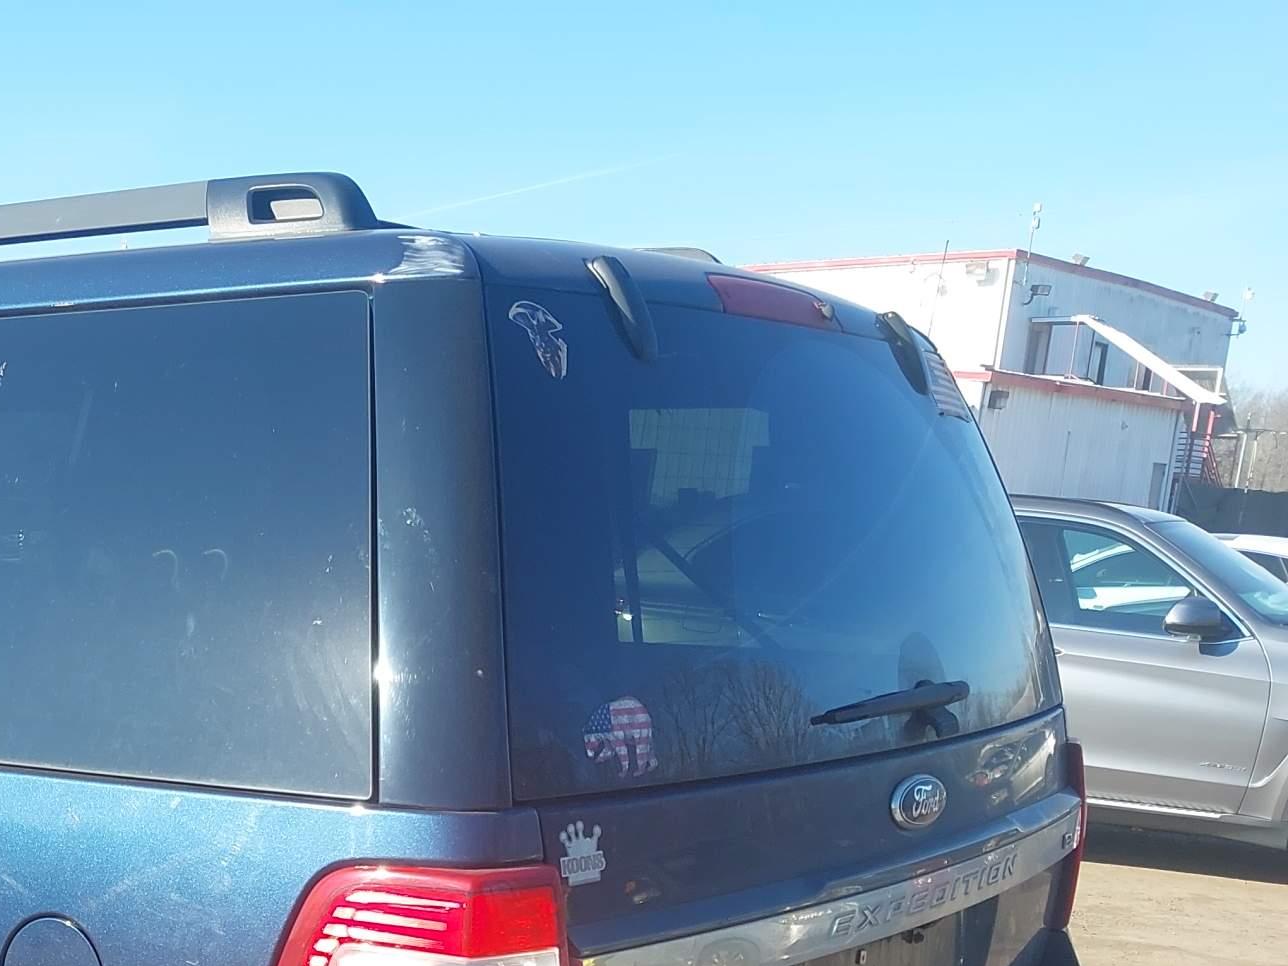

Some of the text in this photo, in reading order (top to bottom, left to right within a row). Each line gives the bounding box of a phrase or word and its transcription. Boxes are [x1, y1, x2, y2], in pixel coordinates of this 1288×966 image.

[913, 785, 940, 818] Ford
[561, 853, 604, 875] KOONS
[831, 853, 1018, 938] EXPEDITION
